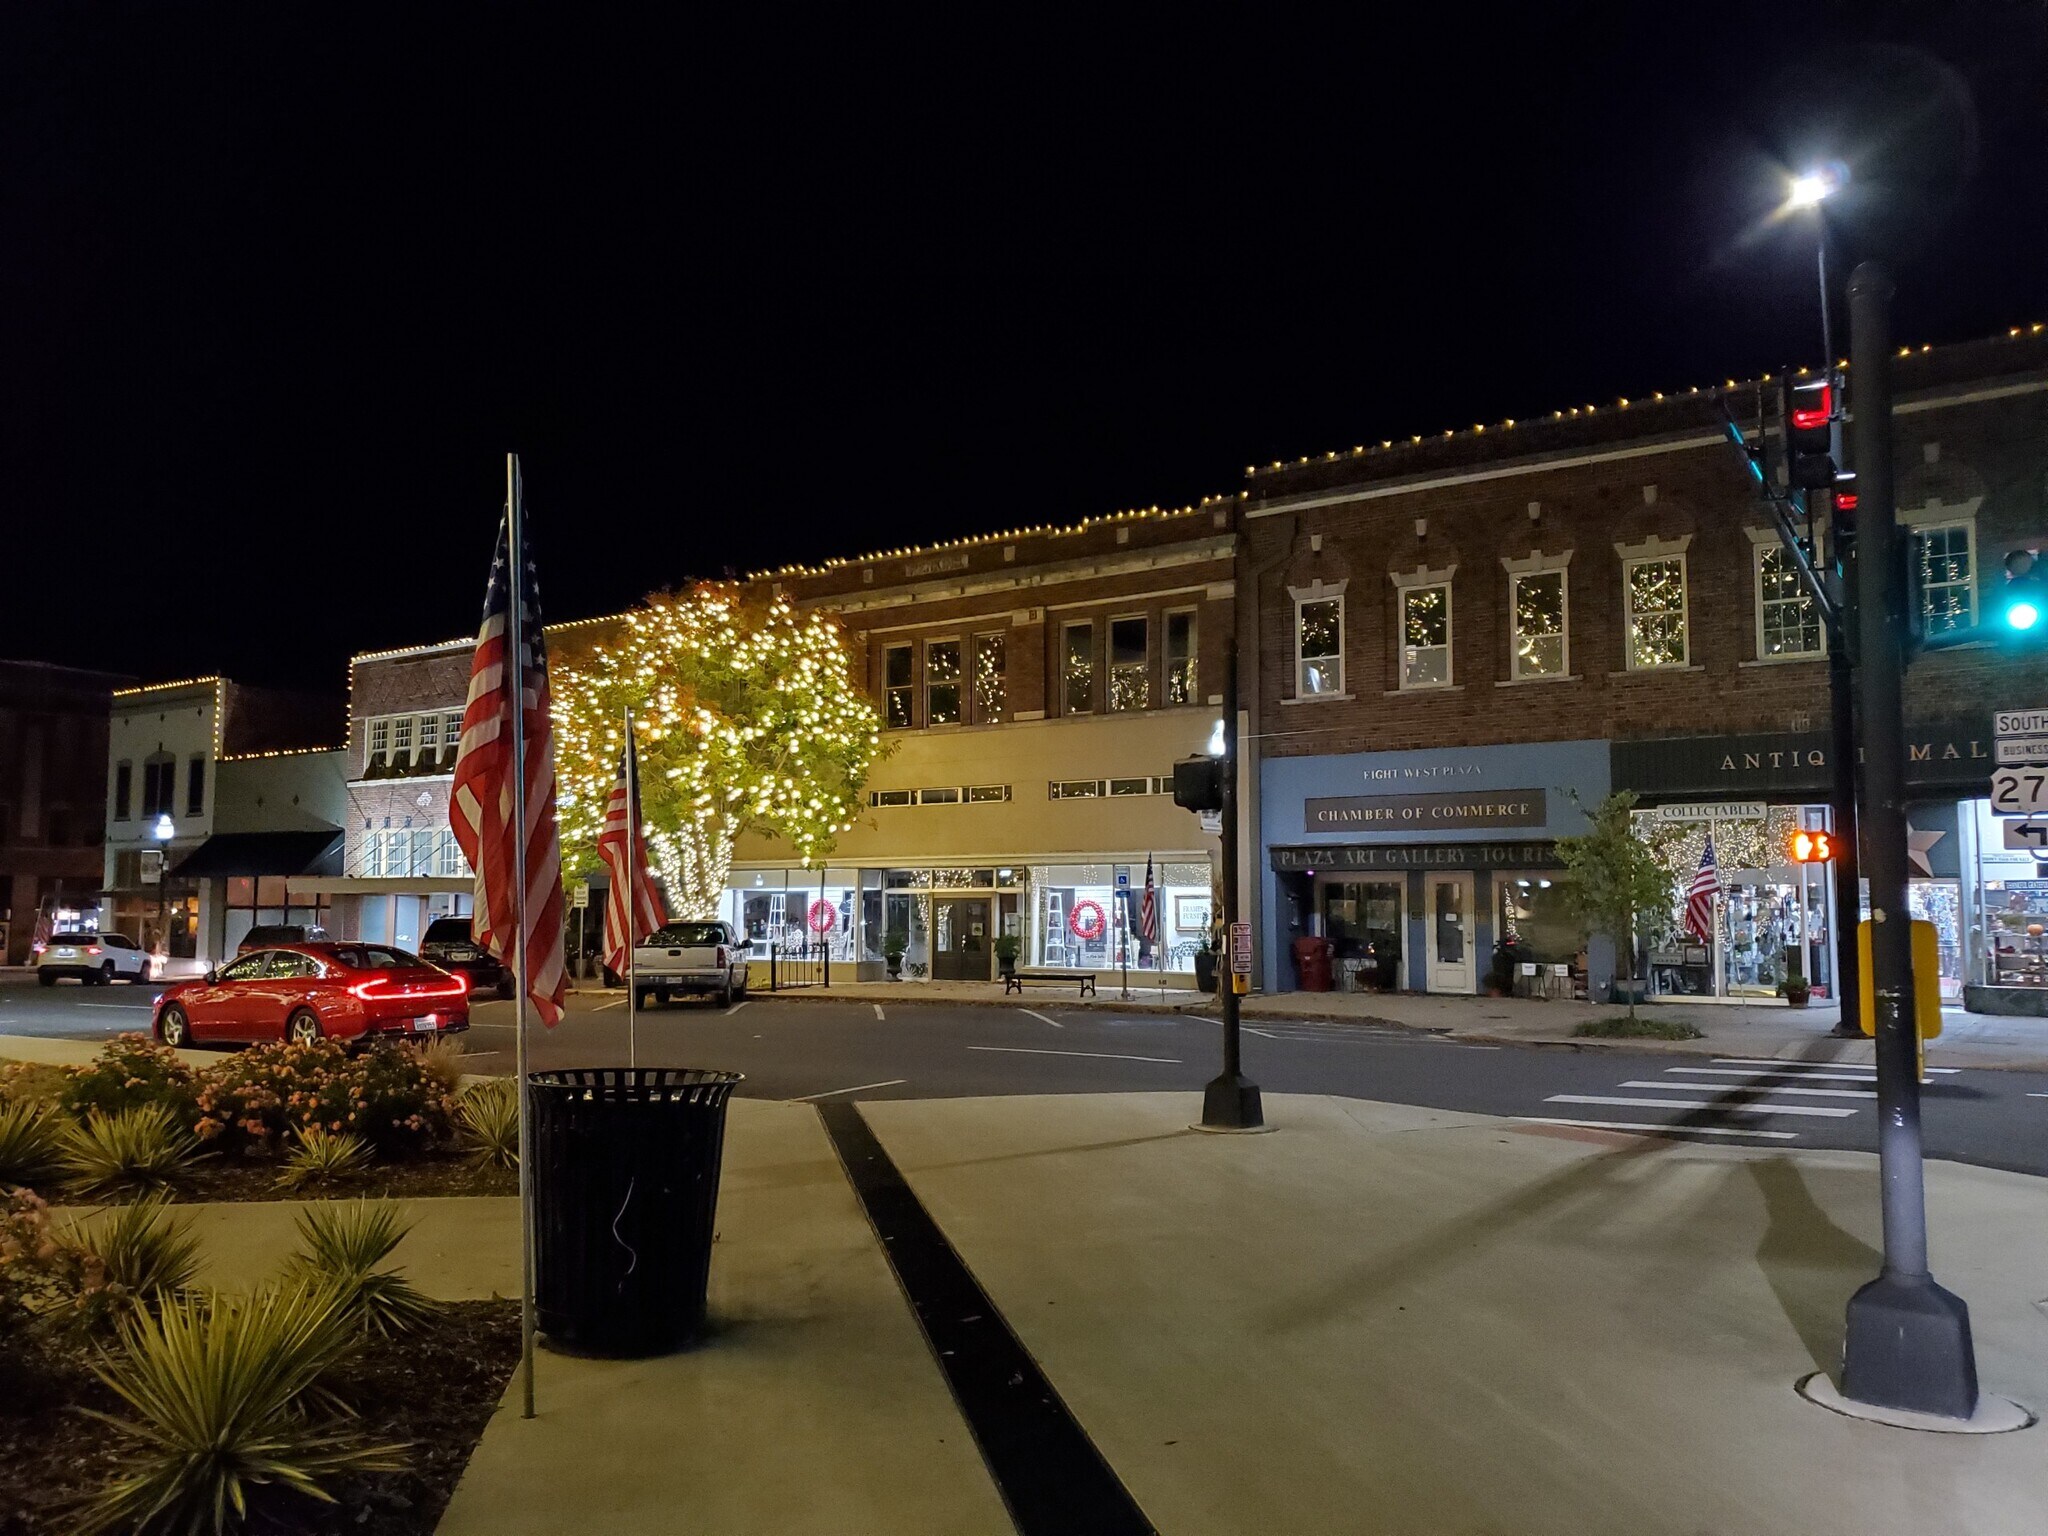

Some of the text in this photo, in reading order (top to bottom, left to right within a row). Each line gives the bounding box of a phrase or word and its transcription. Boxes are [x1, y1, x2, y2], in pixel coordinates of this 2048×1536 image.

[1999, 715, 2048, 732] SOUTH
[1720, 740, 1987, 771] ANTIQ MAL
[1363, 764, 1482, 780] EIGHT WEST PLAZA
[1318, 802, 1530, 822] CHAMBER OF COMMERCE
[1663, 805, 1760, 818] COLLECTABLES
[1281, 850, 1335, 866] PLAZA
[1344, 849, 1377, 864] ART
[1385, 847, 1466, 864] GALLERY
[1480, 846, 1555, 863] TOURIS
